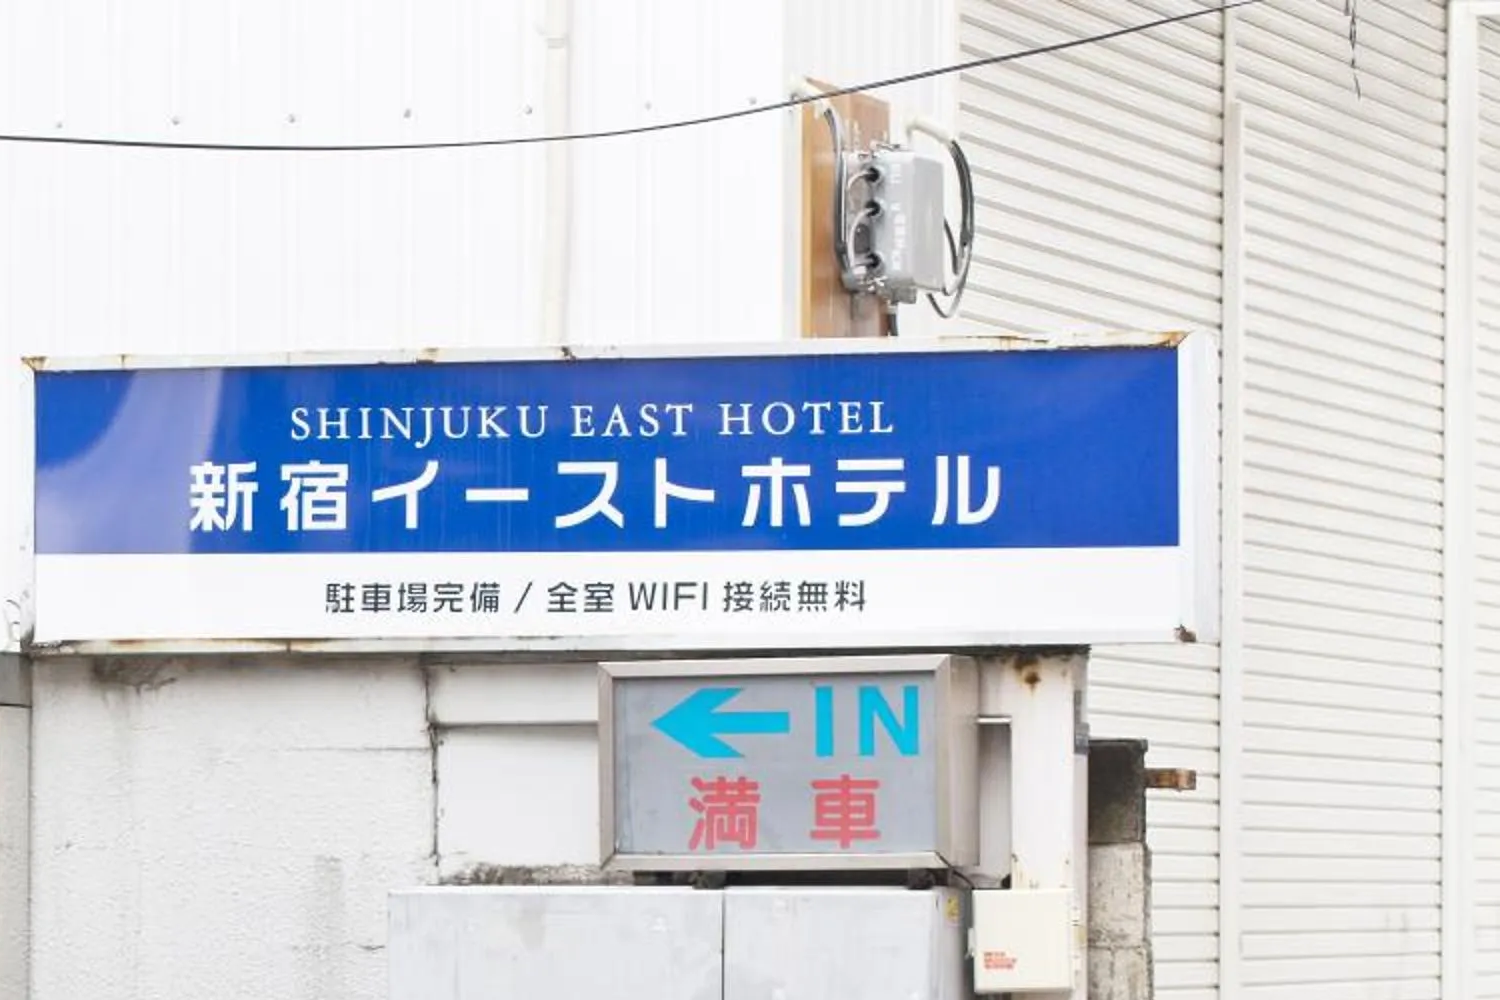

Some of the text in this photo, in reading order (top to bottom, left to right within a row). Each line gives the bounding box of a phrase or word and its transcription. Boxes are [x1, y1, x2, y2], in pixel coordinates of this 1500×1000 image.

[291, 401, 893, 449] SHINJUKU EAST HOTEL
[188, 455, 1001, 532] 新宿イーストホテル
[325, 582, 500, 613] 駐車場完備
[547, 581, 615, 613] 全室
[628, 581, 708, 611] WIFI
[723, 580, 866, 613] 接続無料
[814, 685, 920, 757] IN
[688, 774, 882, 851] 満車
